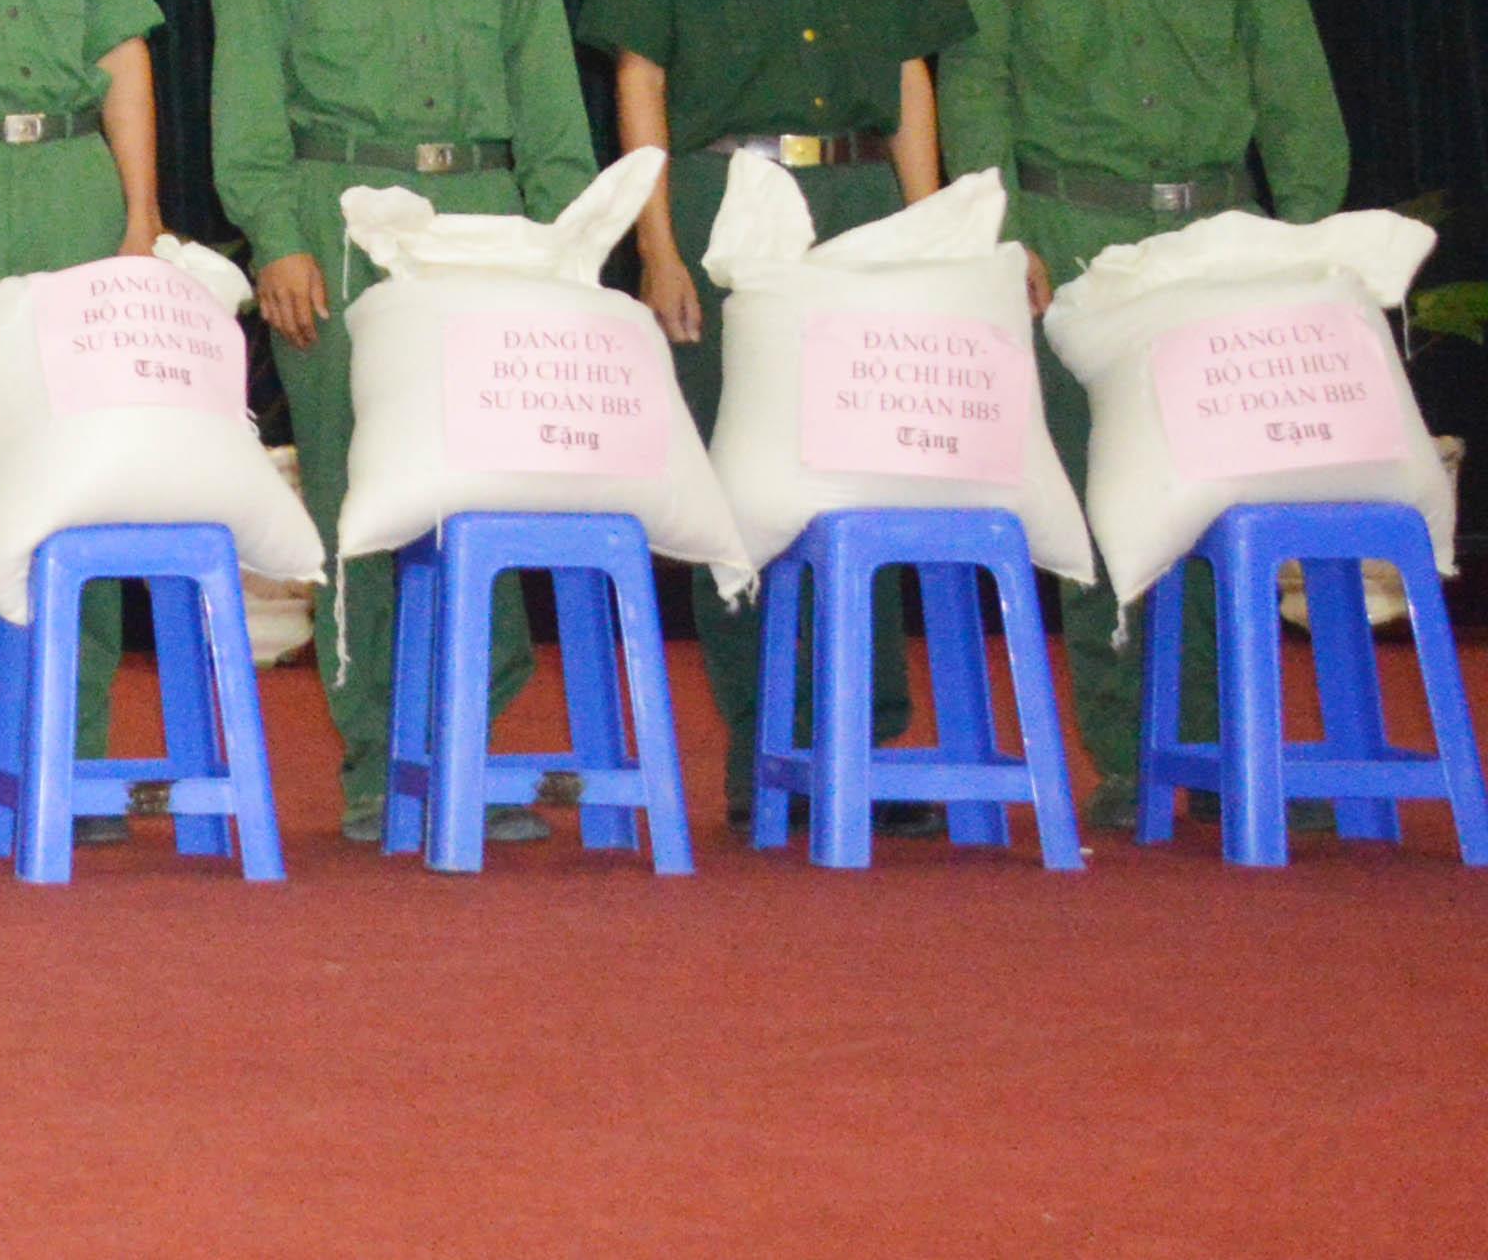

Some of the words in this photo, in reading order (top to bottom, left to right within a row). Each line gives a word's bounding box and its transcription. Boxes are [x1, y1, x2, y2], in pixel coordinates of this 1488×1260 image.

[586, 363, 633, 386] HUY
[1300, 351, 1352, 375] HUY
[946, 365, 997, 391] HUY
[1322, 381, 1368, 403] BB5
[600, 395, 642, 417] BB5
[960, 400, 1002, 423] BB5
[539, 423, 600, 451] Tặng
[896, 425, 960, 456] Tặng
[1265, 421, 1334, 446] Tặng
